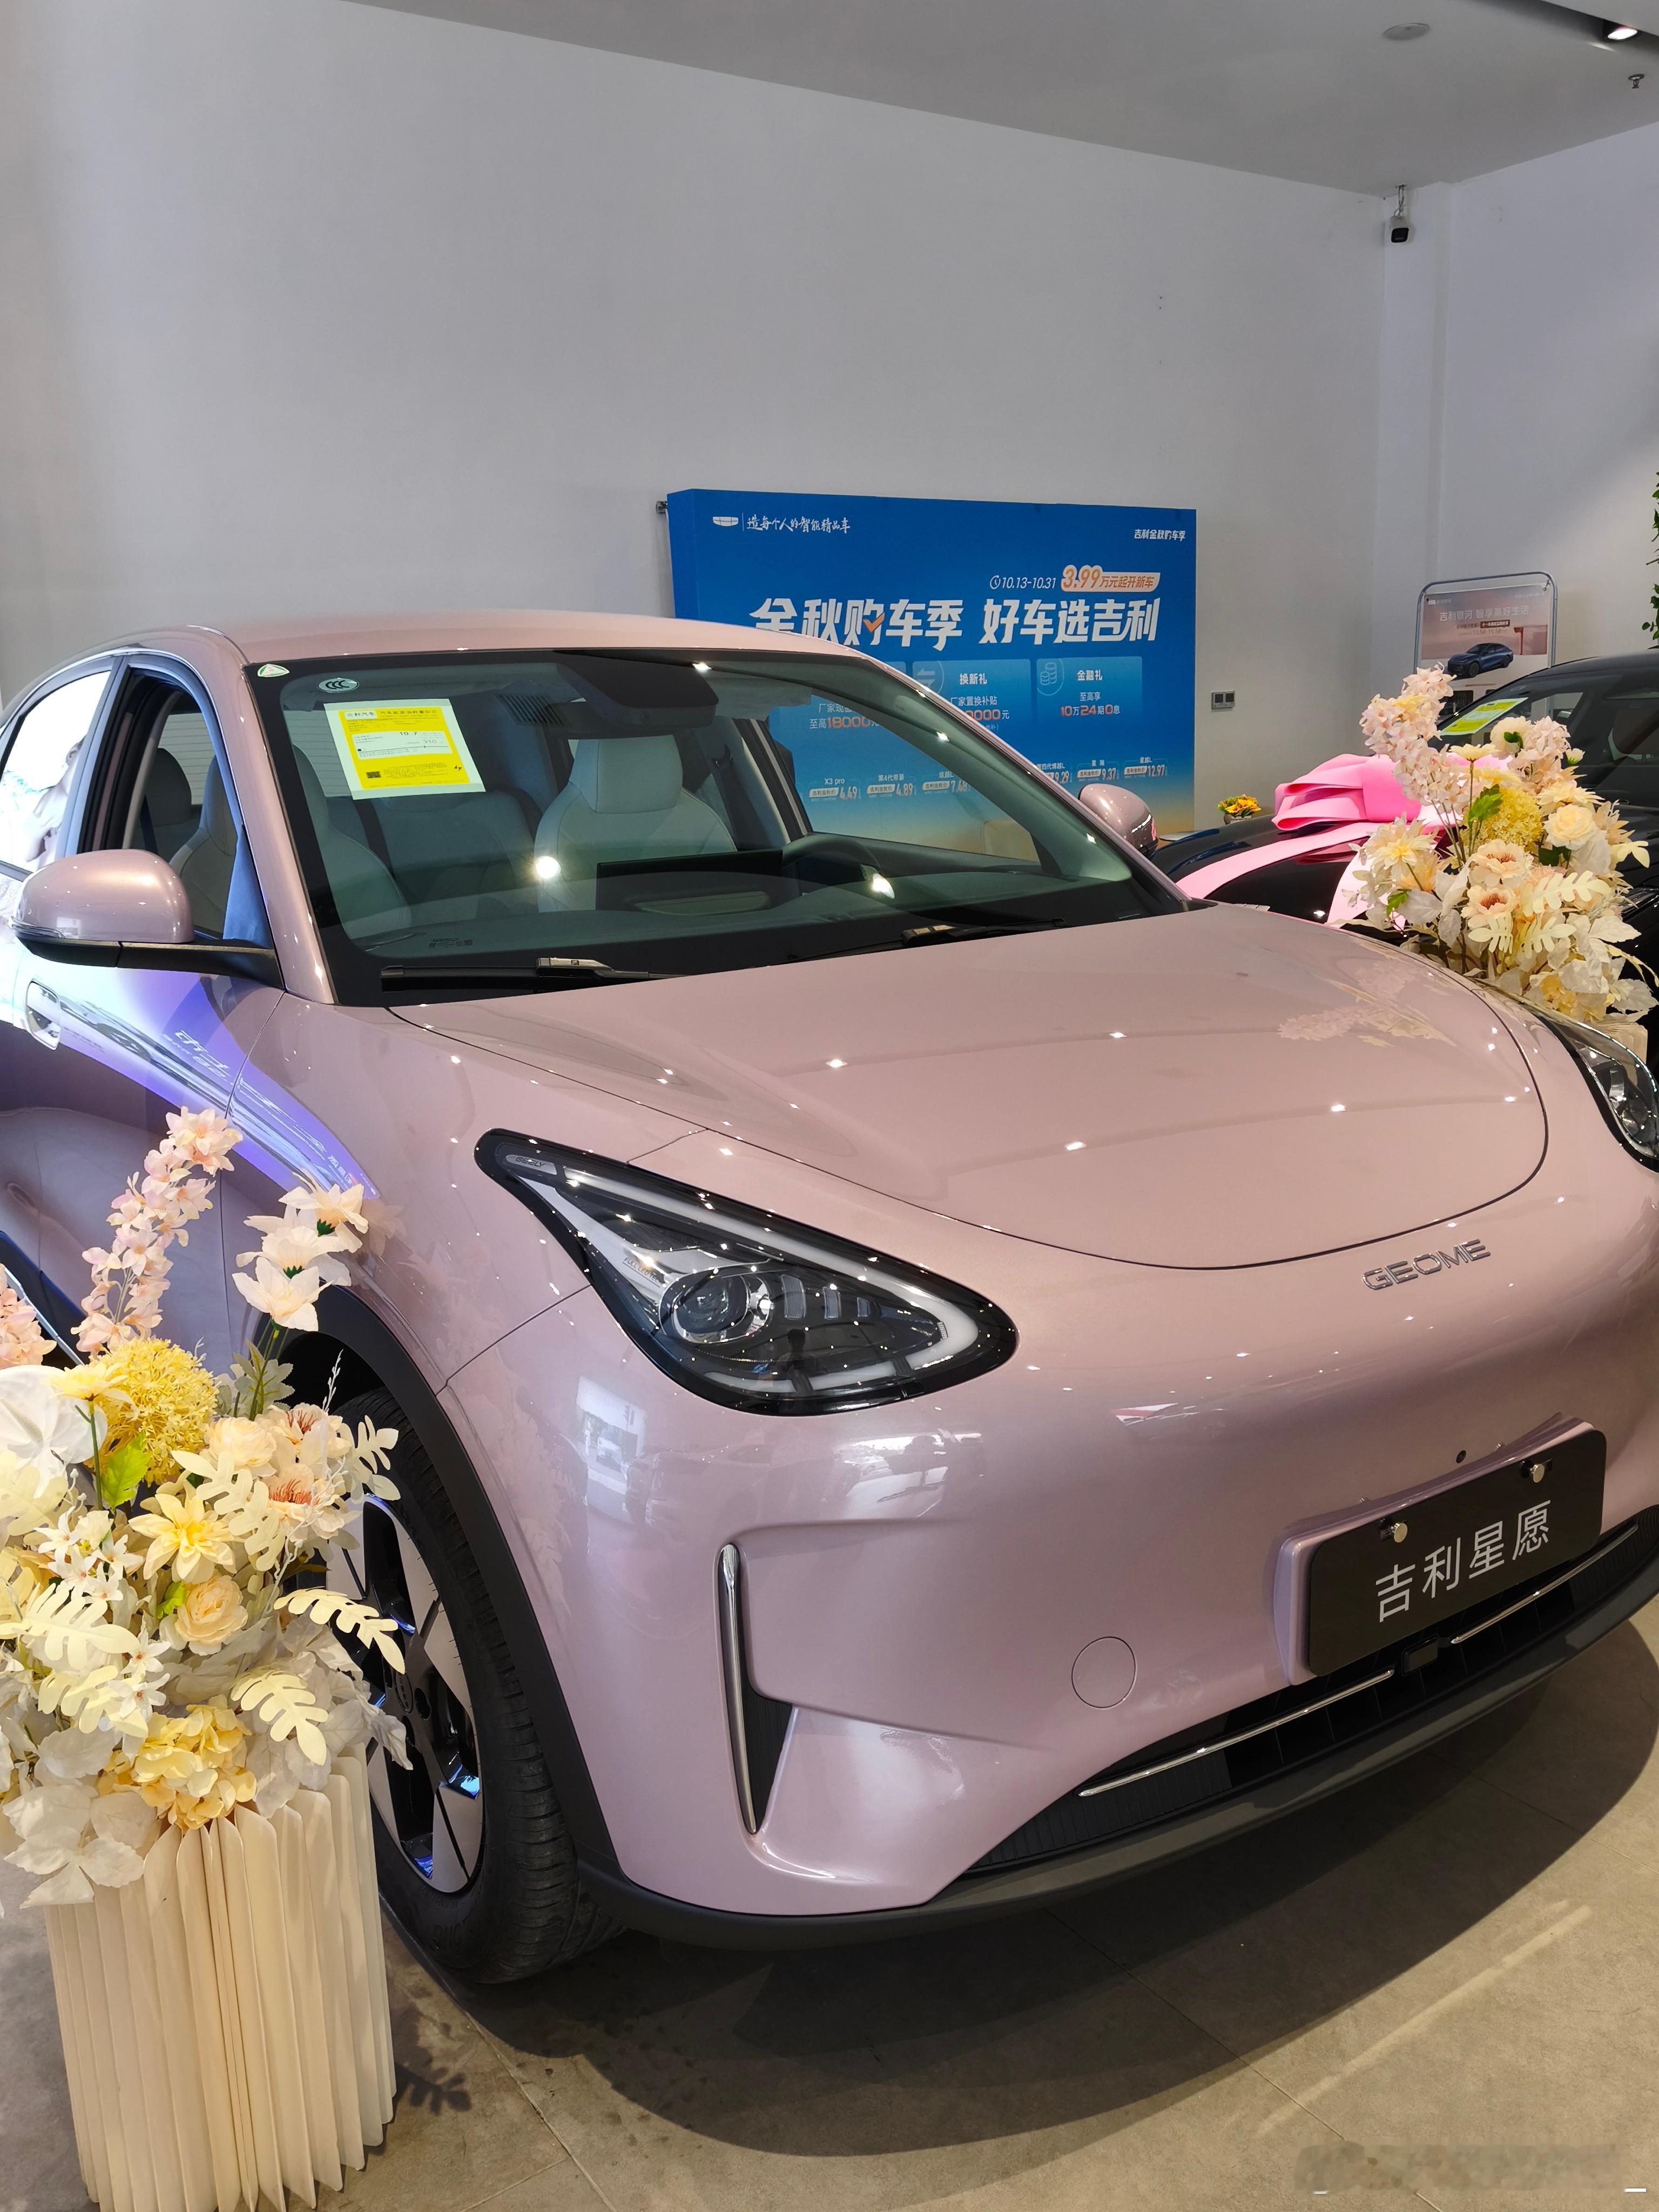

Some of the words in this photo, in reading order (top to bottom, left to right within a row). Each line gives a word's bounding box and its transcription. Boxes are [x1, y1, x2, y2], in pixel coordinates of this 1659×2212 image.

[1134, 529, 1186, 542] 吉利金秋购车季
[1002, 576, 1056, 589] 10.13-10.31
[979, 597, 1160, 644] 好车选吉利
[960, 673, 987, 685] 换新礼
[1077, 670, 1103, 681] 金融礼
[950, 696, 997, 706] 厂家置换补贴
[1080, 692, 1101, 702] 至高享
[1061, 704, 1121, 716] 10万24期0息
[516, 1157, 547, 1168] GEELY
[624, 1257, 637, 1269] FULL
[1361, 1239, 1491, 1290] GEOME
[1375, 1500, 1551, 1623] 吉利星愿
